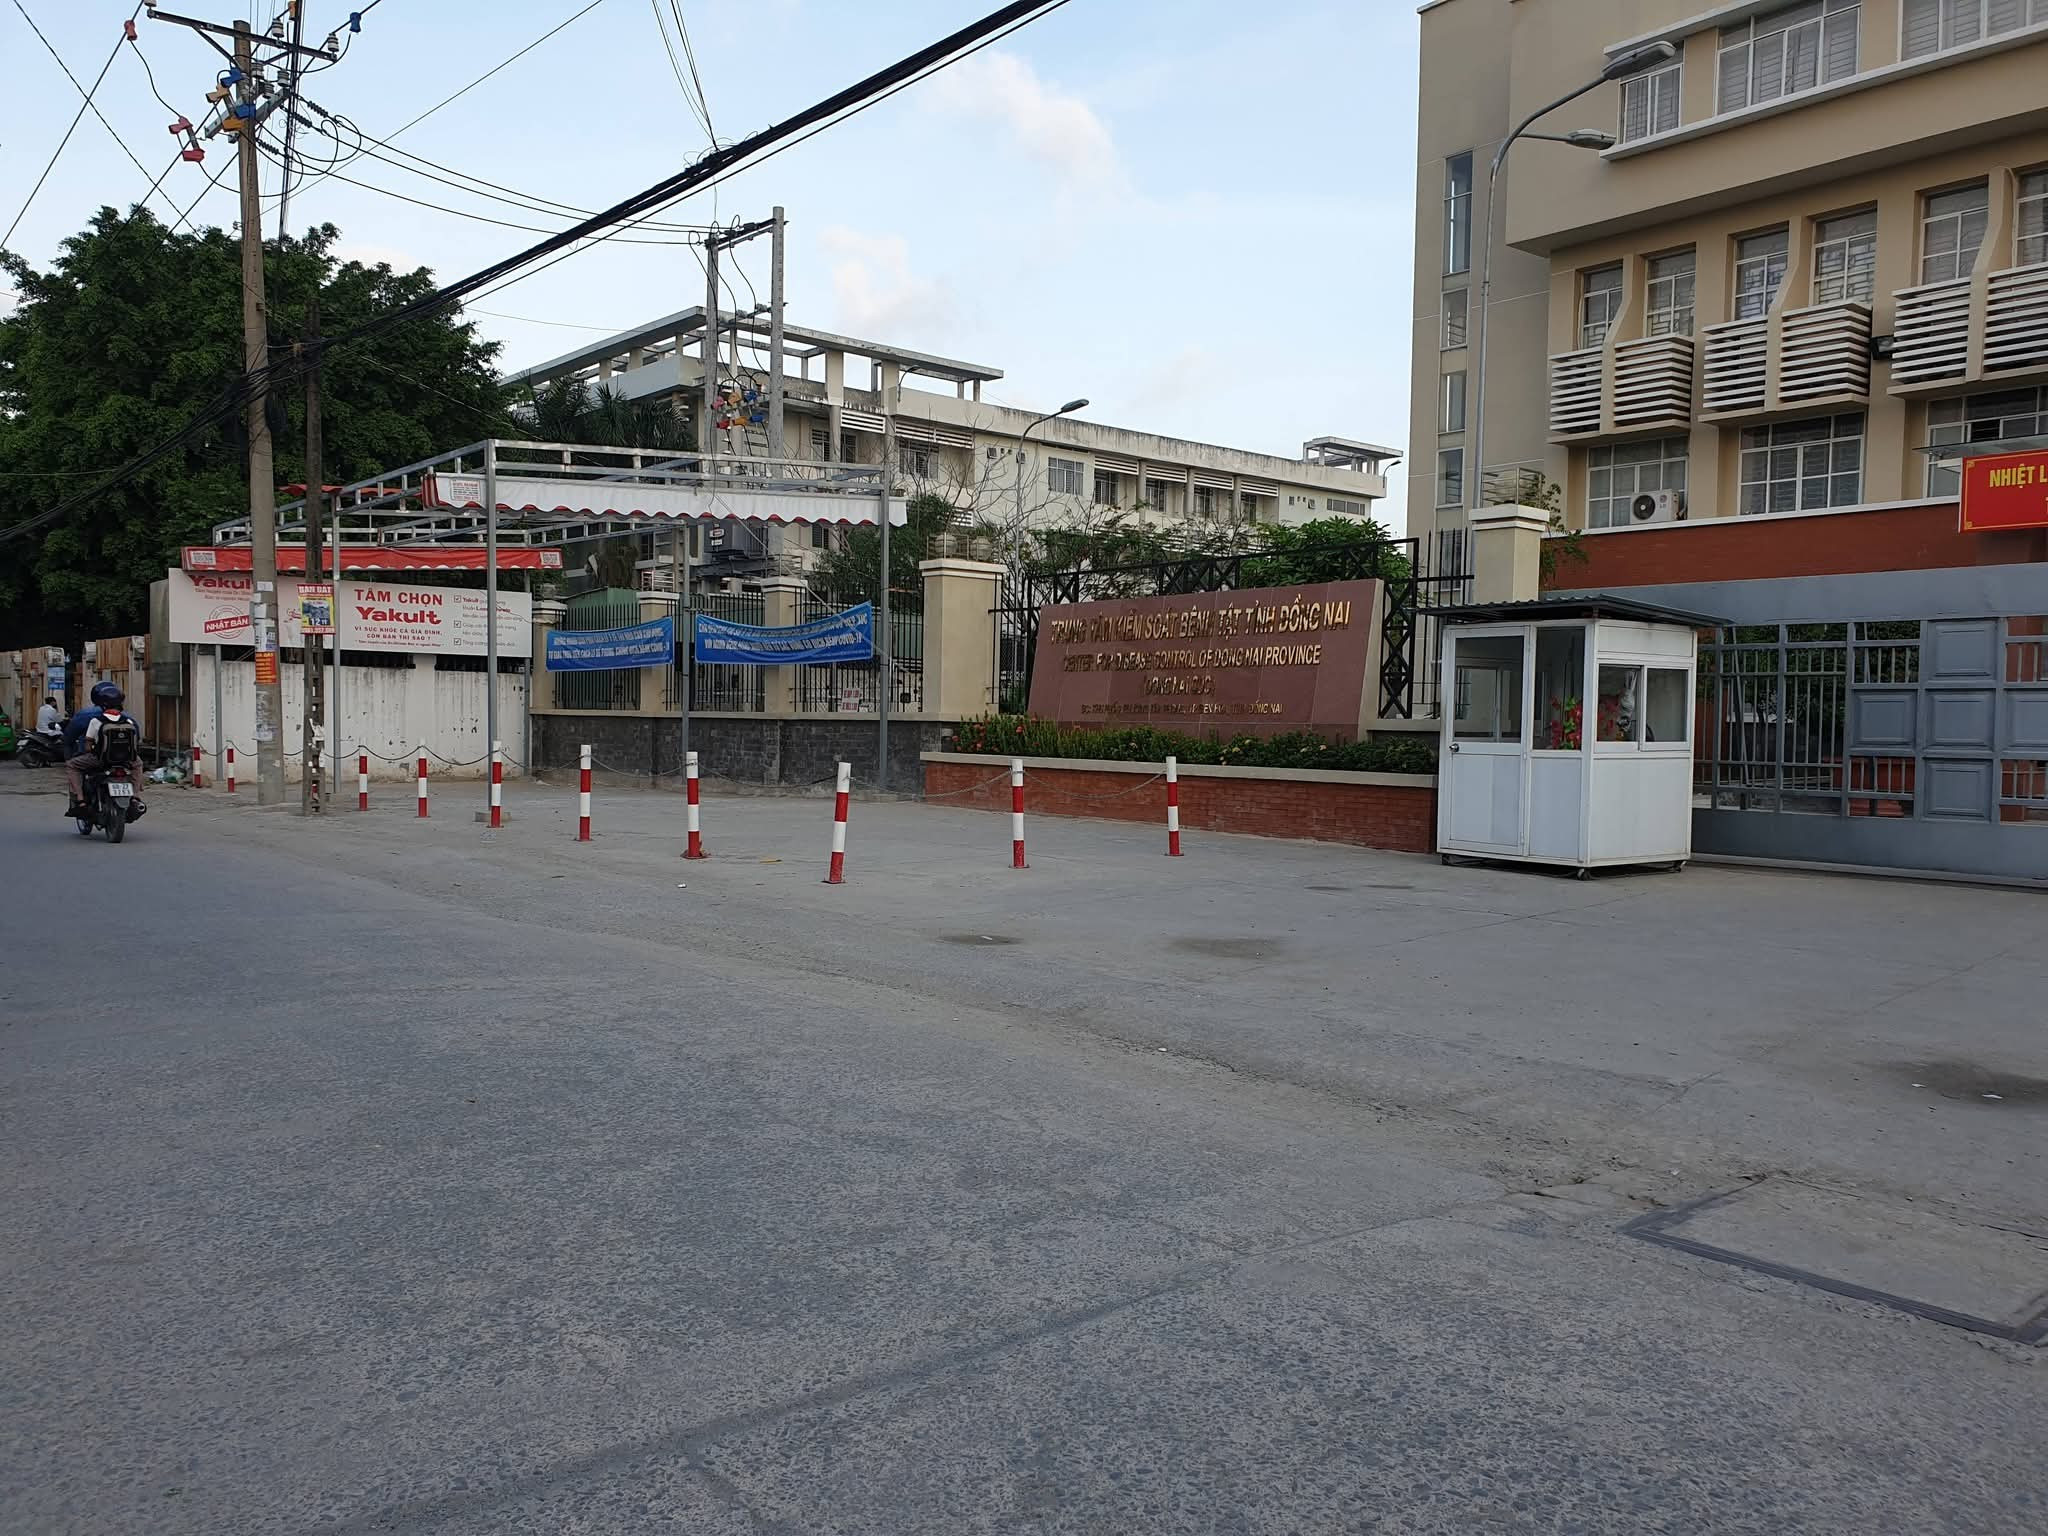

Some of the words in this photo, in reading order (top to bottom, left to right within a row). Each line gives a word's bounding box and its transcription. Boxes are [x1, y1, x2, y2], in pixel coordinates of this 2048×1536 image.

[1989, 463, 2036, 488] NHIỆT
[188, 574, 251, 590] Yakul
[354, 587, 391, 602] TÂM
[398, 592, 443, 607] CHỌN
[311, 617, 321, 626] 12
[355, 606, 442, 625] Yakult
[1051, 619, 1087, 643] TRUNG
[1144, 606, 1178, 640] SOÁT
[1179, 604, 1214, 642] BỆNH
[1218, 602, 1242, 640] TẬT
[1245, 600, 1276, 634] TỈNH
[1279, 593, 1321, 633] ĐỒNG
[1323, 601, 1351, 629] NAI
[1095, 652, 1115, 671] FOR
[1152, 649, 1197, 670] CONTROL
[1199, 649, 1213, 668] OF
[1213, 647, 1244, 667] DONG
[1245, 647, 1264, 666] NAI
[1264, 644, 1322, 665] PROVINCE
